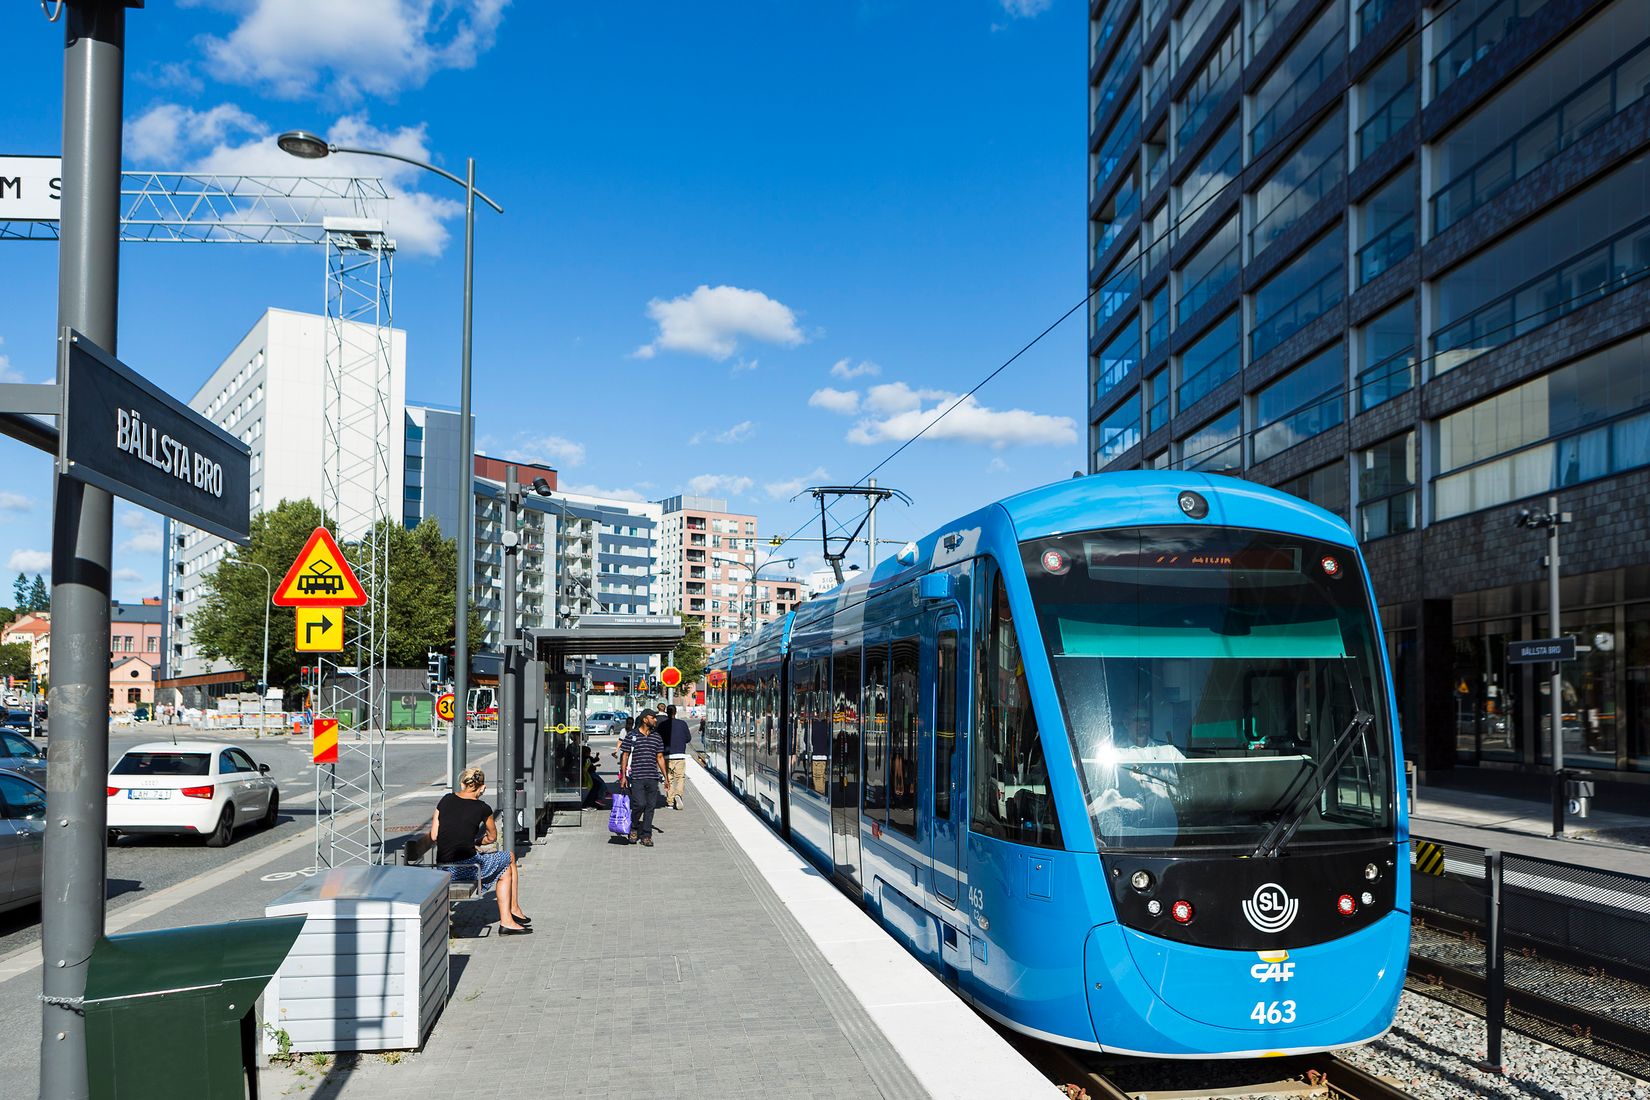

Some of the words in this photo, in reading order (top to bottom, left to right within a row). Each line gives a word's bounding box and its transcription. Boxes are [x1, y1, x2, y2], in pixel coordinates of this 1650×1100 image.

[117, 407, 191, 484] BÄLLSTA
[194, 452, 222, 498] BRO
[968, 885, 984, 910] 463
[1259, 892, 1284, 912] SL
[1250, 962, 1296, 983] CAF
[1250, 999, 1297, 1025] 463
